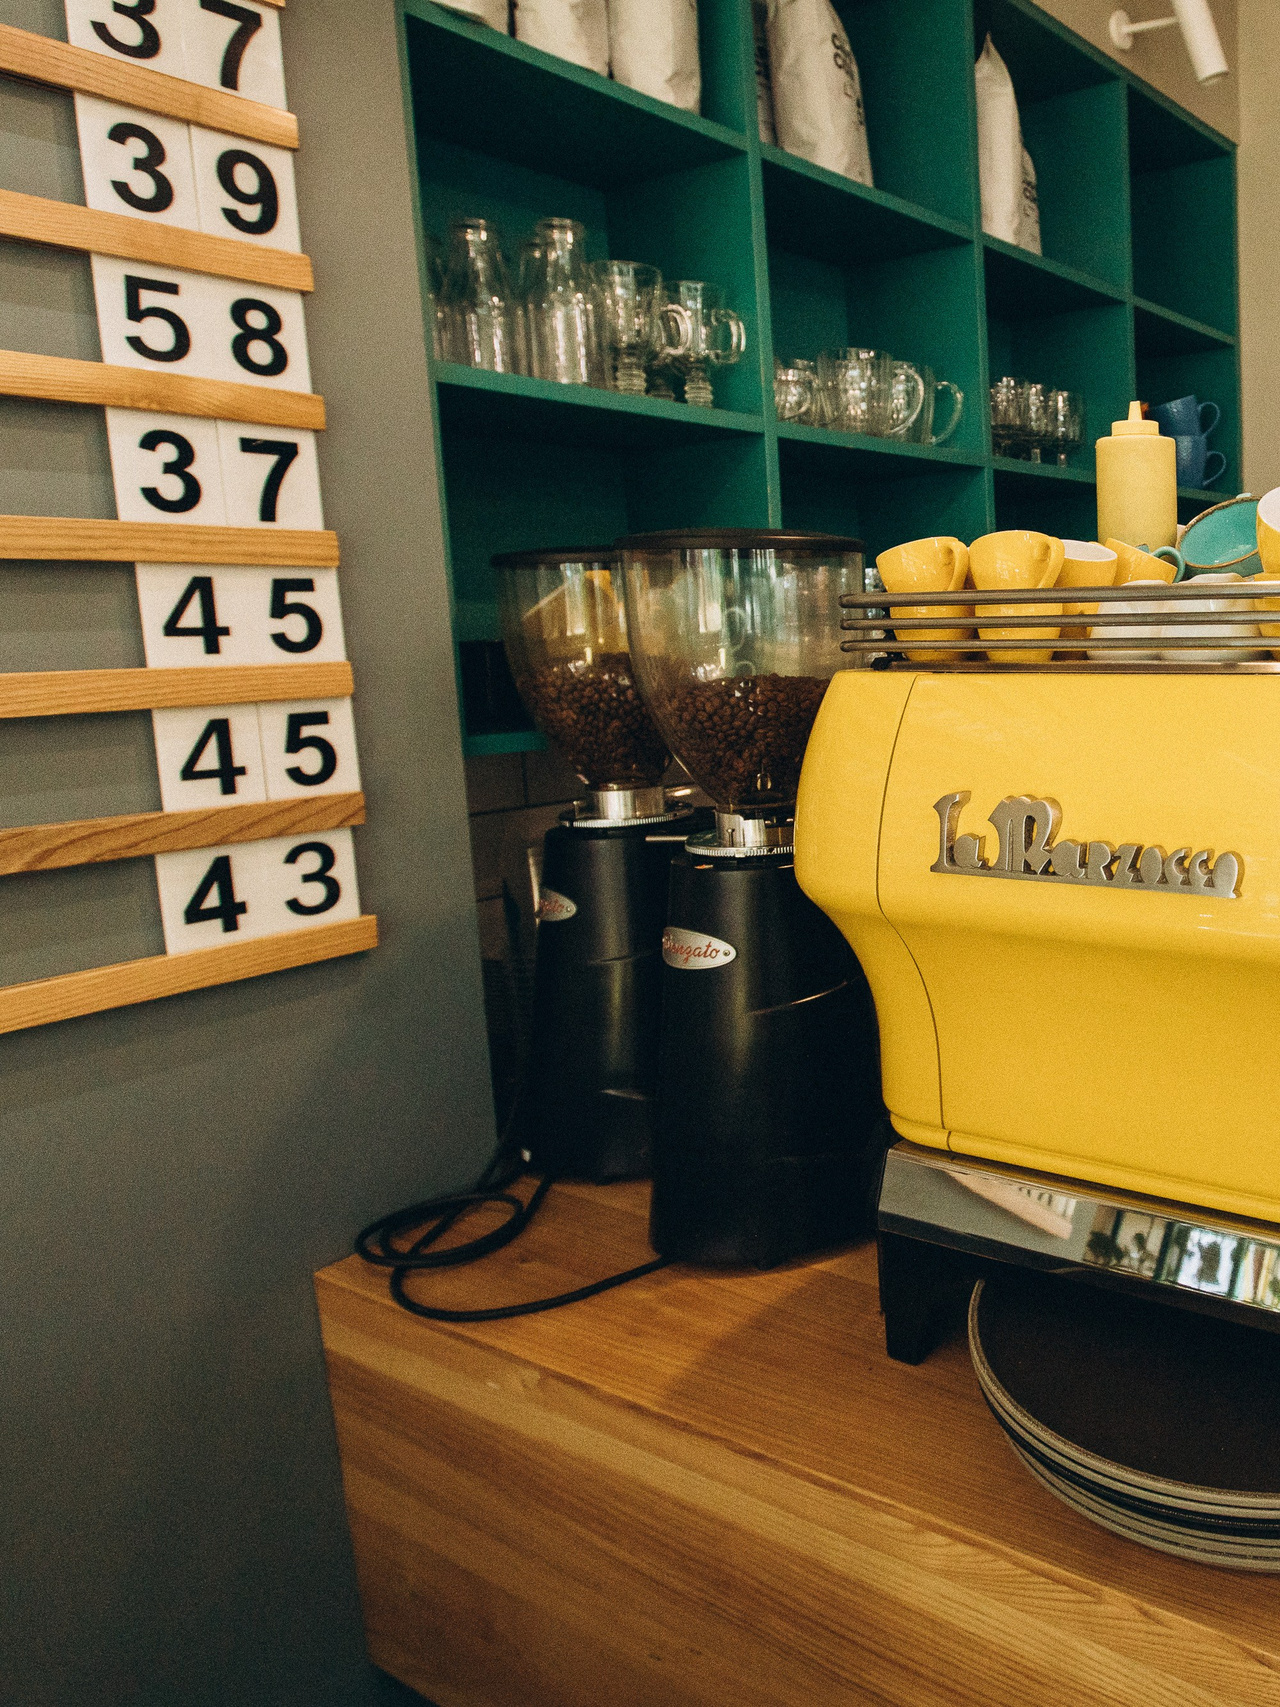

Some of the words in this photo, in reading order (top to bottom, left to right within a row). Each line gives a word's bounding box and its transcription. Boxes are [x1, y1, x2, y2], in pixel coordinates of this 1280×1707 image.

[107, 122, 279, 235] 39
[125, 274, 288, 376] 58
[139, 429, 299, 522] 37
[163, 576, 323, 654] 45
[181, 711, 337, 795] 45
[184, 841, 341, 932] 43
[930, 790, 988, 874] La
[988, 793, 1245, 898] Marzocco
